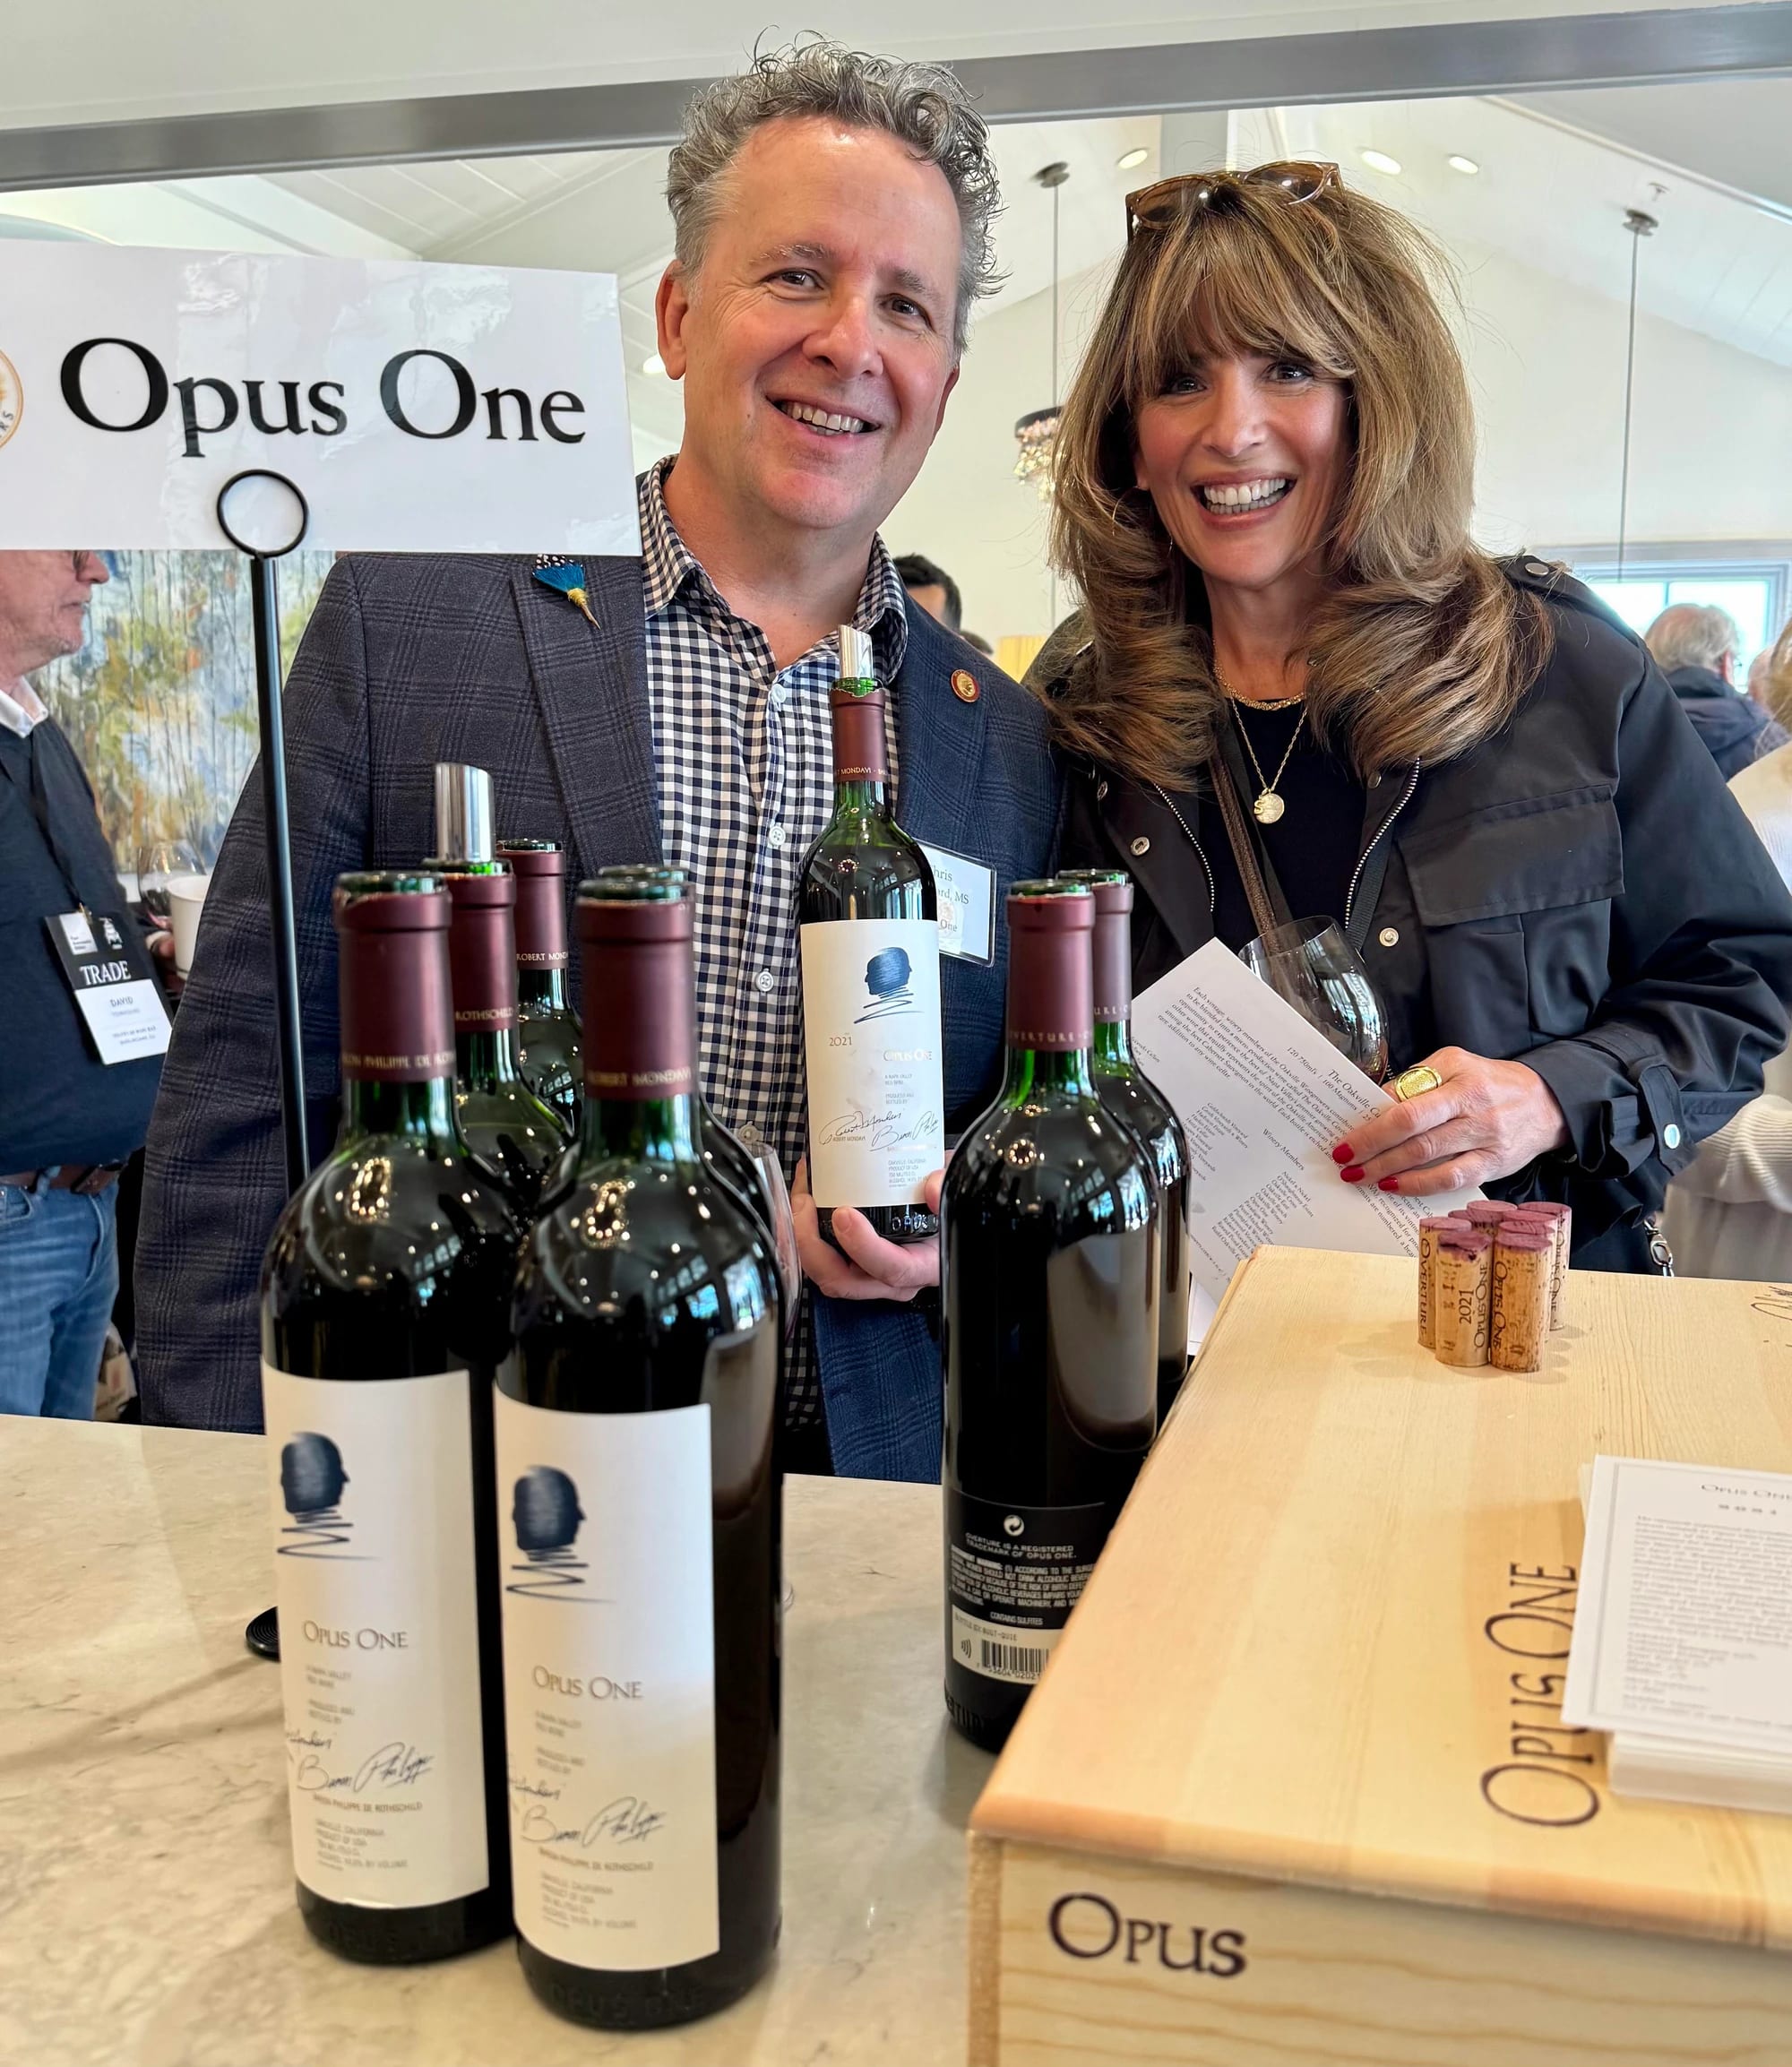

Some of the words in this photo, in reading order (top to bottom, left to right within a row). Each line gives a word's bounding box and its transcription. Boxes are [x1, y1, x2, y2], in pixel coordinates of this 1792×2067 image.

[60, 337, 349, 458] Opus
[379, 349, 587, 444] One
[840, 767, 872, 775] MONDAVI
[932, 864, 952, 882] hris
[954, 891, 969, 905] MS
[79, 960, 132, 986] TRADE
[516, 952, 546, 961] ROBERT
[110, 995, 134, 1007] DAVID
[455, 1008, 513, 1021] ROTHSCHILD
[829, 1036, 852, 1046] 2021
[1167, 1023, 1189, 1042] addition
[1193, 986, 1207, 1001] Each
[1225, 1016, 1242, 1032] winery
[1241, 1031, 1264, 1052] members
[1279, 1063, 1300, 1083] Oakville
[1299, 1081, 1330, 1110] Winegrowers
[1171, 1003, 1186, 1017] other
[1197, 1026, 1210, 1037] that
[1249, 1072, 1260, 1081] the
[1276, 1096, 1287, 1105] the
[1285, 1103, 1306, 1122] Oakville
[1305, 1121, 1329, 1142] American
[1192, 996, 1201, 1005] be
[1285, 1082, 1304, 1096] called
[1300, 1094, 1312, 1105] The
[1310, 1103, 1331, 1122] Oakville
[1238, 1051, 1249, 1061] the
[1247, 1058, 1260, 1070] best
[1265, 1074, 1280, 1089] Napa
[1181, 1023, 1192, 1032] the
[1189, 1029, 1202, 1042] best
[1201, 1039, 1225, 1062] Cabernet
[1223, 1059, 1249, 1083] Sauvignon
[1253, 1087, 1263, 1096] the
[1277, 1107, 1290, 1120] Each
[1308, 1135, 1327, 1152] etched
[1327, 1068, 1342, 1084] The
[1341, 1082, 1370, 1108] Oakville
[1332, 1087, 1357, 1111] Magnums
[1262, 1127, 1281, 1148] Winery
[1279, 1146, 1304, 1170] Members
[1369, 1201, 1379, 1211] are
[1377, 1197, 1405, 1228] recognized
[1401, 1227, 1411, 1237] for
[1391, 1200, 1401, 1208] of
[1397, 1207, 1405, 1216] its
[1419, 1237, 1432, 1336] OVERTURE
[1476, 1261, 1488, 1301] ONE
[1494, 1261, 1509, 1309] OPUS
[1459, 1289, 1475, 1325] 2021
[1474, 1304, 1487, 1348] OPUS
[1493, 1313, 1507, 1350] ONE
[965, 1531, 1001, 1548] OVERTURE
[1003, 1542, 1012, 1550] IS
[1012, 1543, 1020, 1551] A
[1021, 1545, 1074, 1553] REGISTERED
[966, 1538, 1010, 1557] TRADEMARK
[1011, 1550, 1023, 1558] OF
[1027, 1552, 1052, 1560] OPUS
[303, 1619, 350, 1649] OPUS
[357, 1628, 409, 1651] ONE
[990, 1611, 1016, 1623] CONTAINS
[1017, 1615, 1044, 1626] SULFITES
[533, 1665, 582, 1697] OPUS
[589, 1676, 643, 1701] ONE
[1048, 1892, 1248, 1979] OPUS
